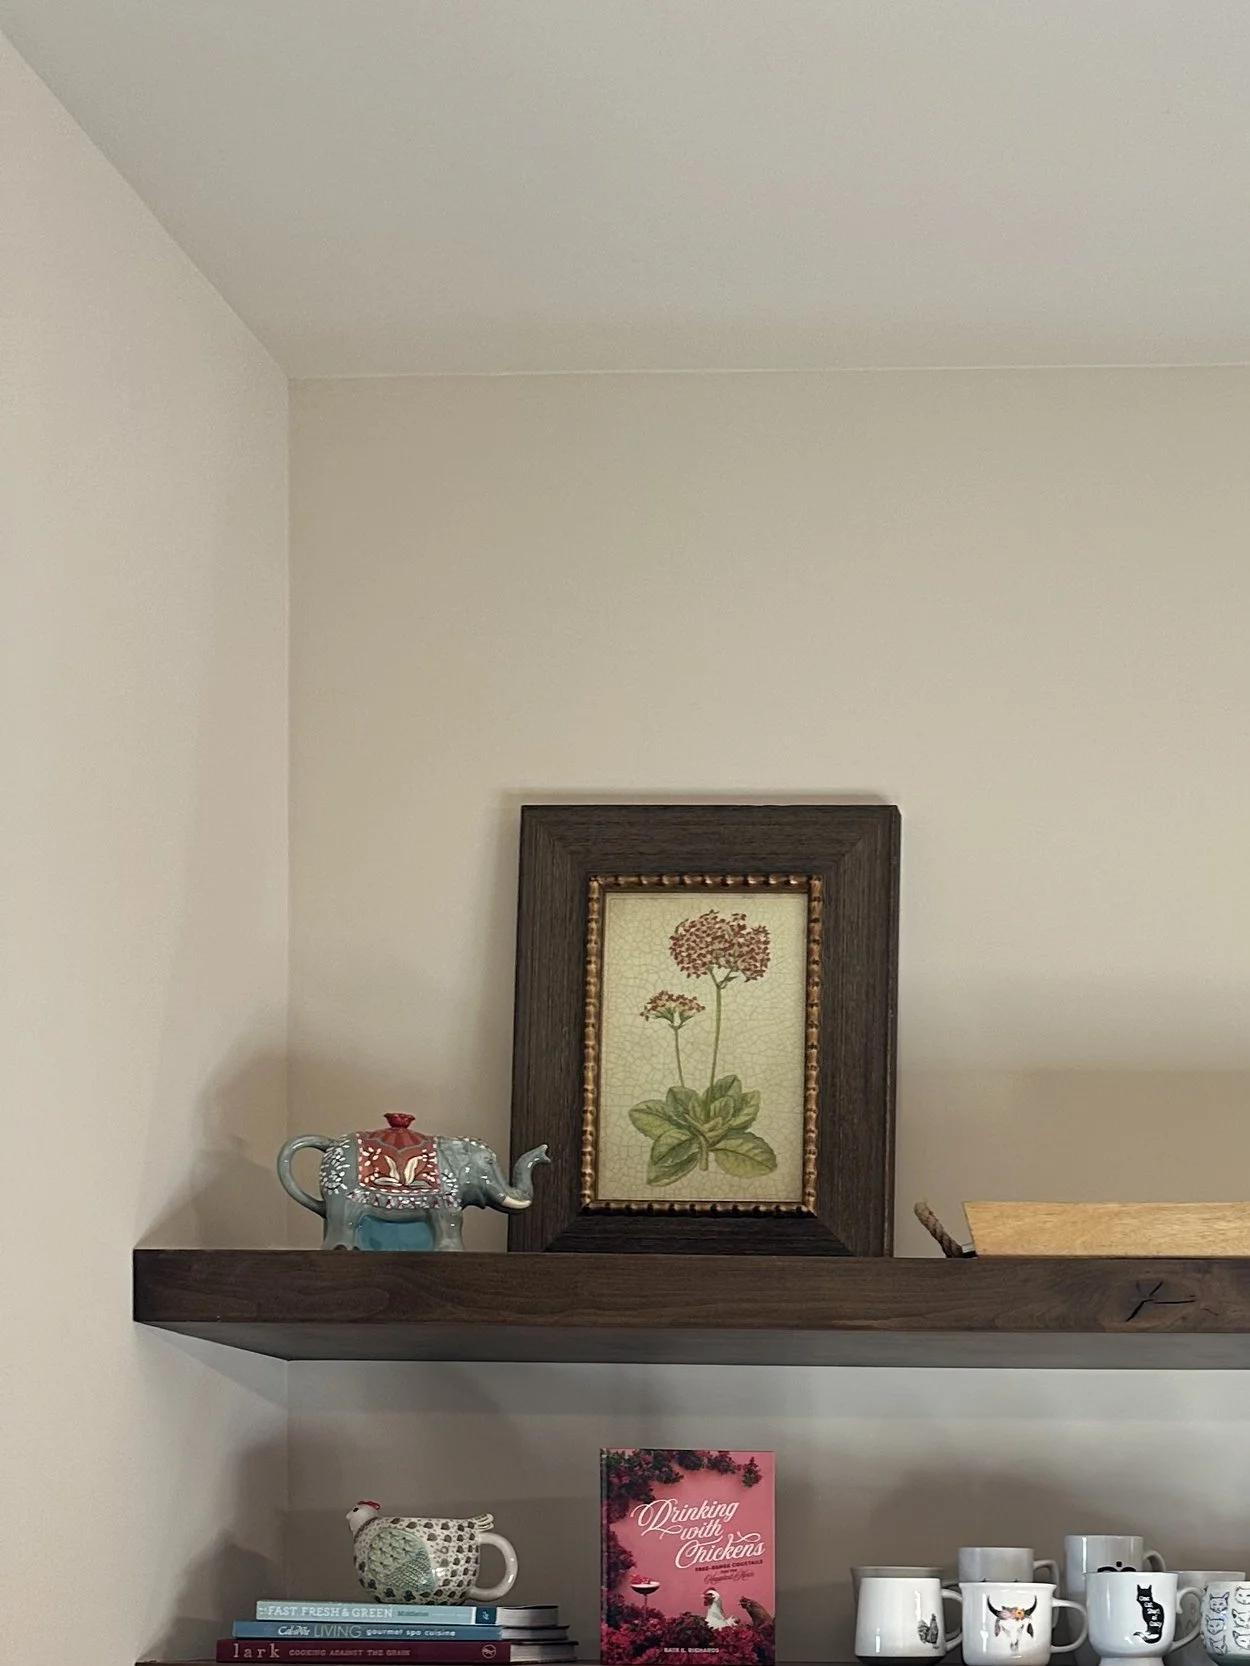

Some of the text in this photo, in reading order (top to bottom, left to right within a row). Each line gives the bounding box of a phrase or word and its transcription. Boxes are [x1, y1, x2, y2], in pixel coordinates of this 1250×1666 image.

[630, 1498, 739, 1537] Drinking
[680, 1519, 724, 1540] with
[675, 1531, 765, 1569] Chickens
[301, 1606, 341, 1617] FRESH
[342, 1607, 350, 1617] &
[351, 1607, 393, 1618] GREEN
[313, 1624, 362, 1638] LIVING
[366, 1628, 403, 1637] gourmet
[406, 1629, 421, 1637] spa
[424, 1629, 456, 1637] cuisine
[233, 1643, 280, 1658] lark
